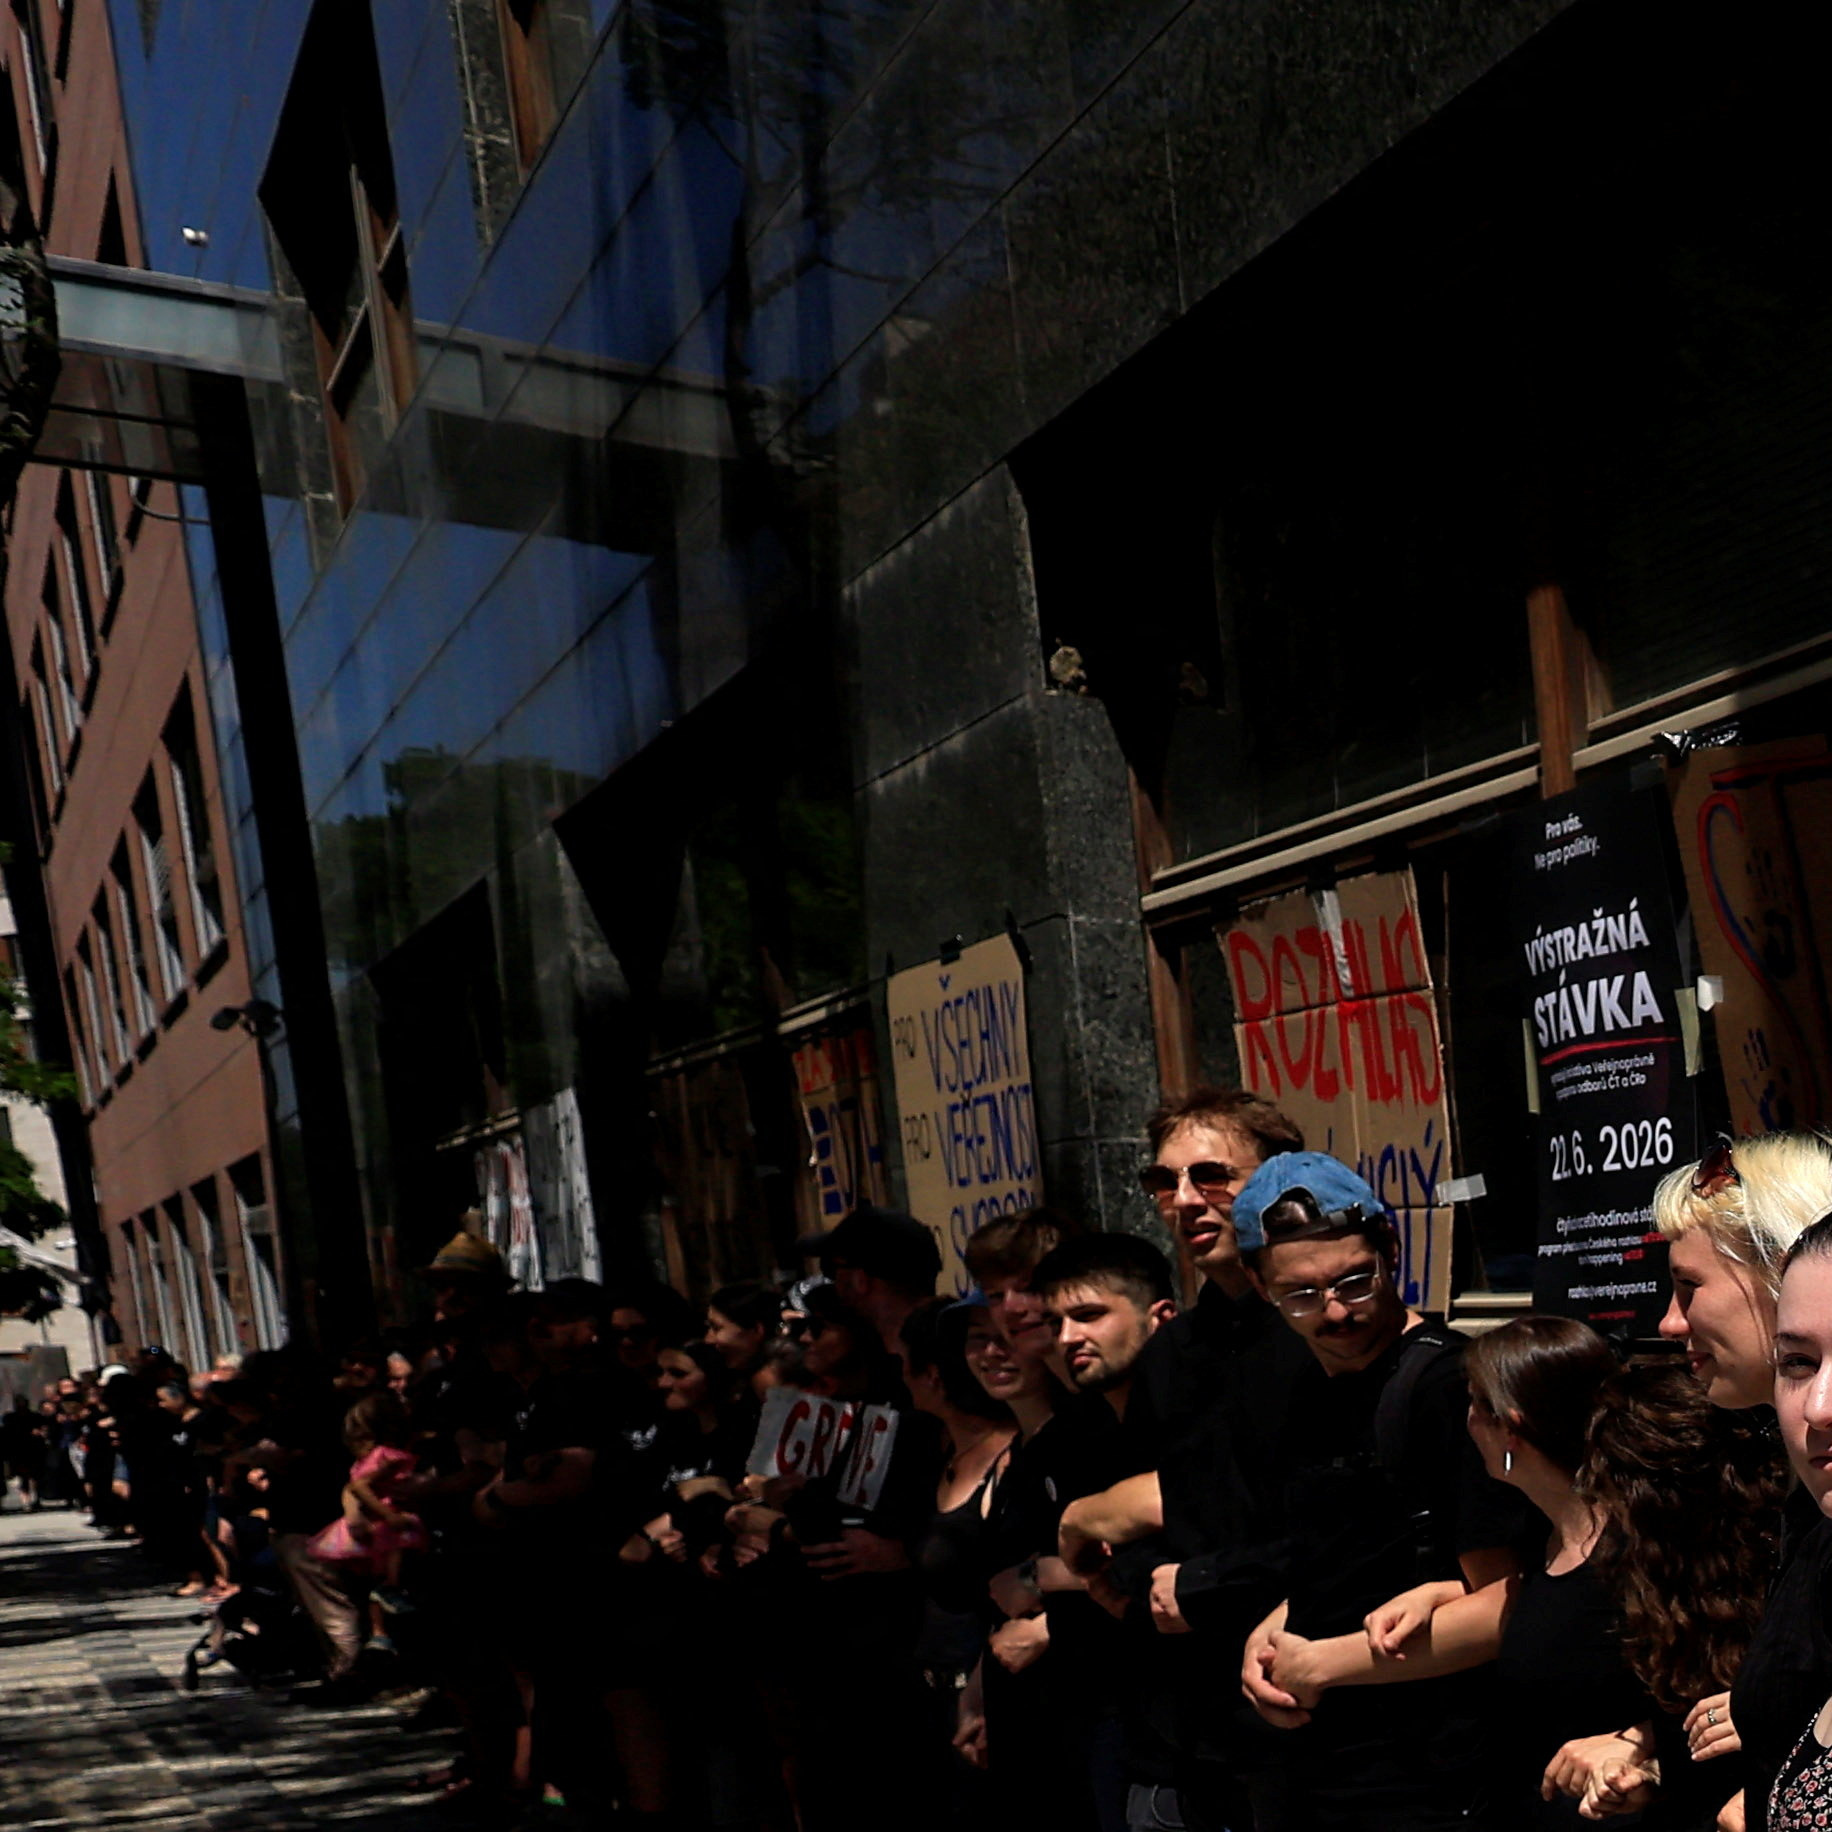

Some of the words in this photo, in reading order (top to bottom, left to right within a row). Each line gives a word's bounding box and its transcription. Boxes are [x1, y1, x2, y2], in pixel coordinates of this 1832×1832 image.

[1545, 822, 1562, 840] Pro
[1524, 896, 1651, 977] VÝSTRAŽNÁ
[920, 974, 1019, 1093] VŠECHNY
[1228, 907, 1441, 1107] ROZHLAS
[1533, 967, 1666, 1049] STÁVKA
[1599, 1116, 1674, 1173] 2026
